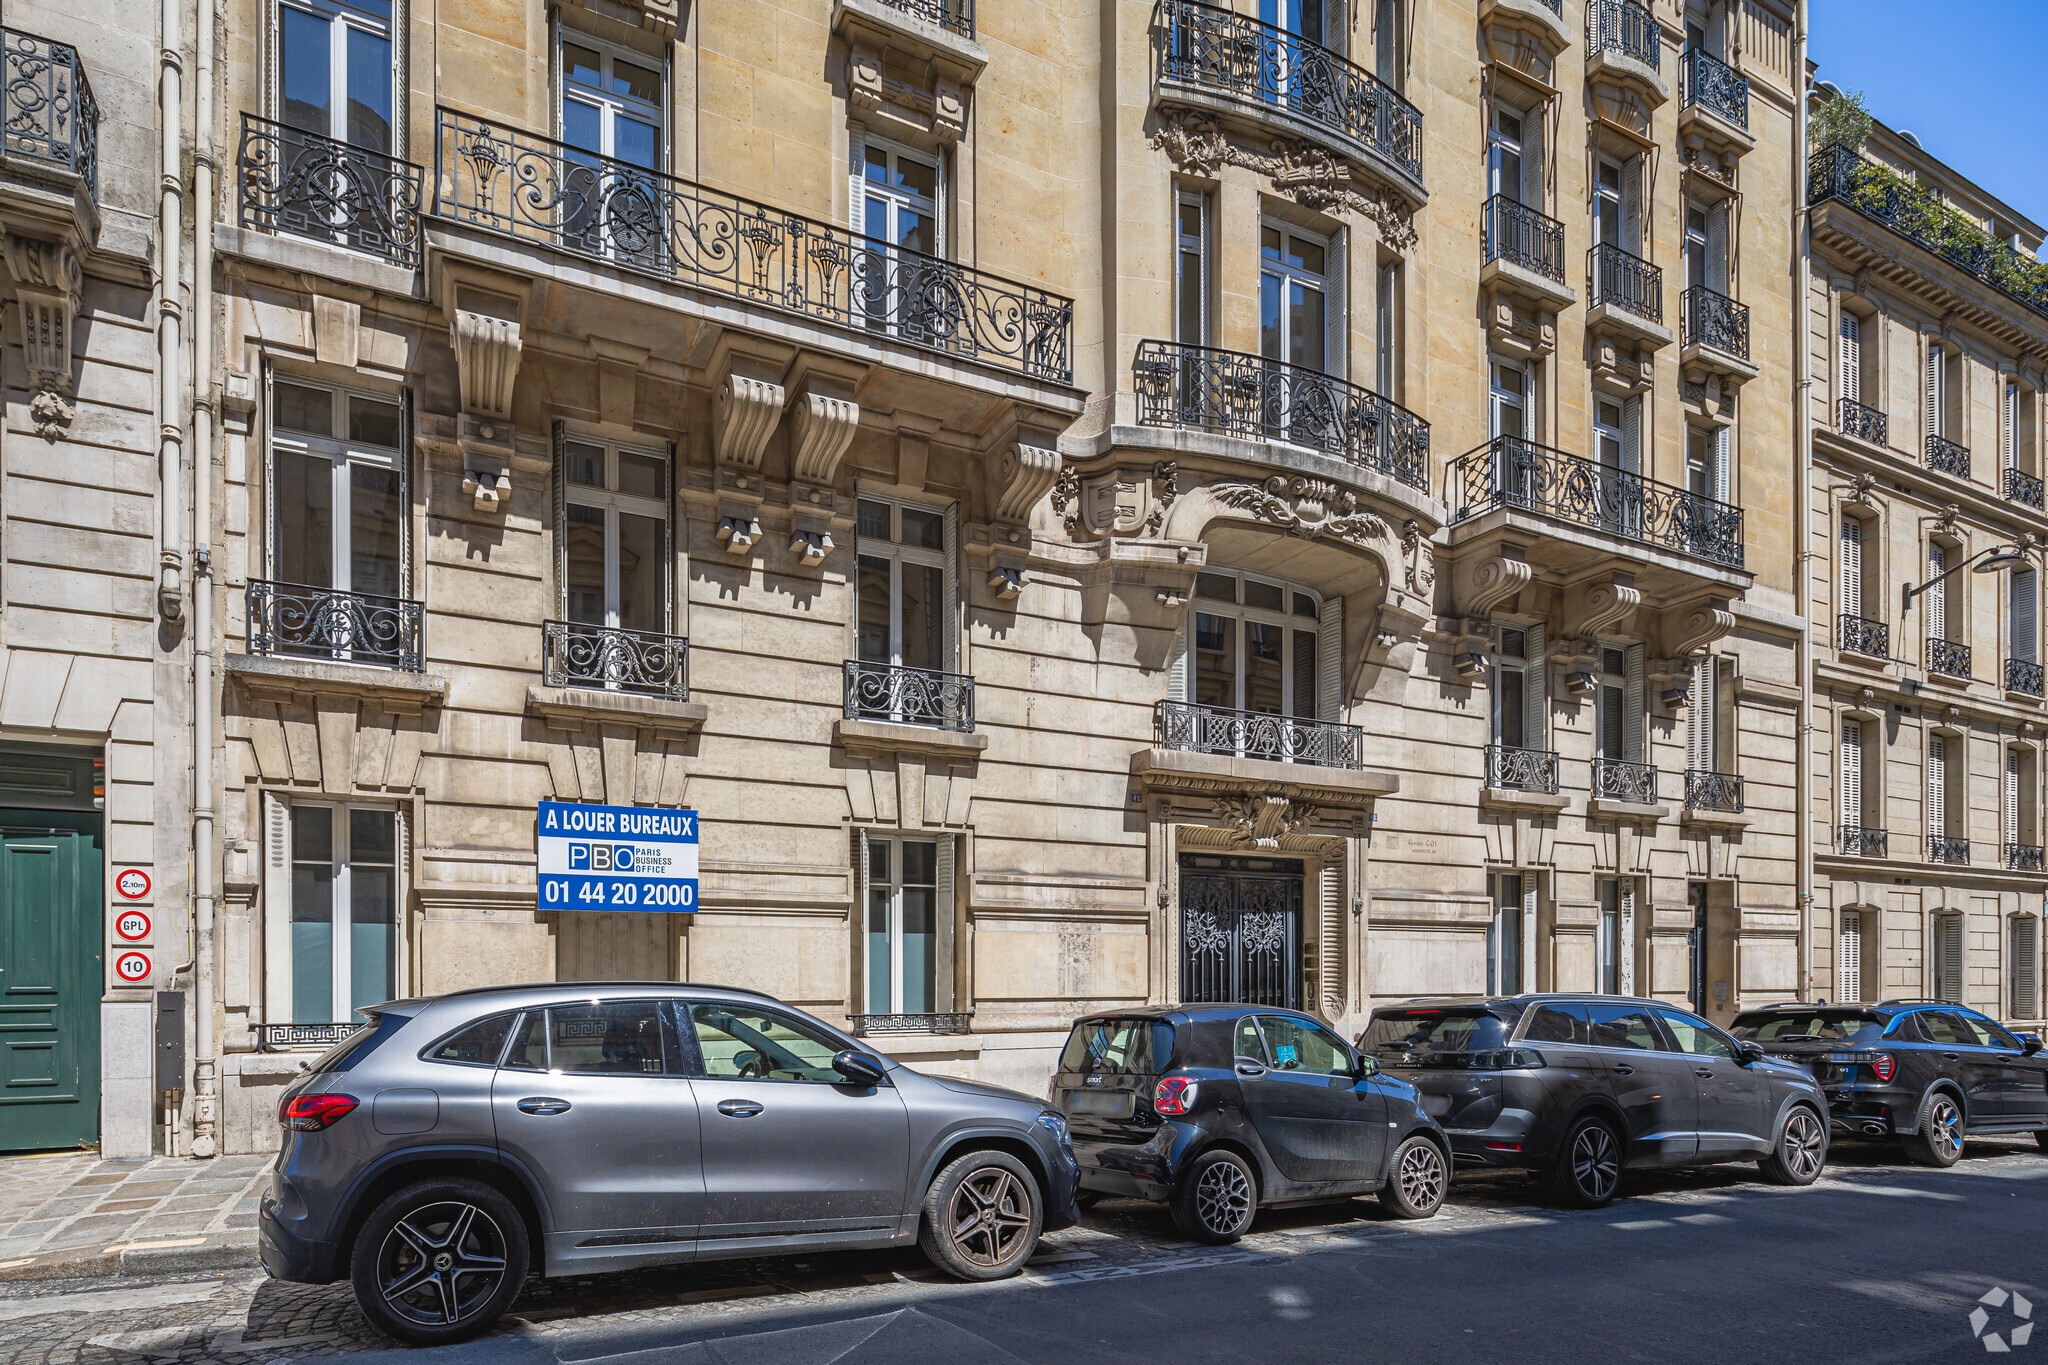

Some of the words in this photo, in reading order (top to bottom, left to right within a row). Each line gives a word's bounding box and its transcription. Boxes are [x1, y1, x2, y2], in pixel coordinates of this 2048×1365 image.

[545, 809, 558, 829] A
[563, 810, 615, 832] LOUER
[620, 813, 692, 836] BUREAUX
[570, 845, 634, 870] PBO
[636, 848, 661, 856] PARIS
[636, 857, 672, 865] BUSINESS
[636, 865, 666, 873] OFFICE
[122, 880, 145, 888] 2.10m
[545, 880, 569, 903] 01
[578, 881, 605, 904] 44
[611, 882, 637, 905] 20
[643, 883, 693, 906] 2000
[123, 920, 144, 931] GPL
[124, 961, 143, 972] 10
